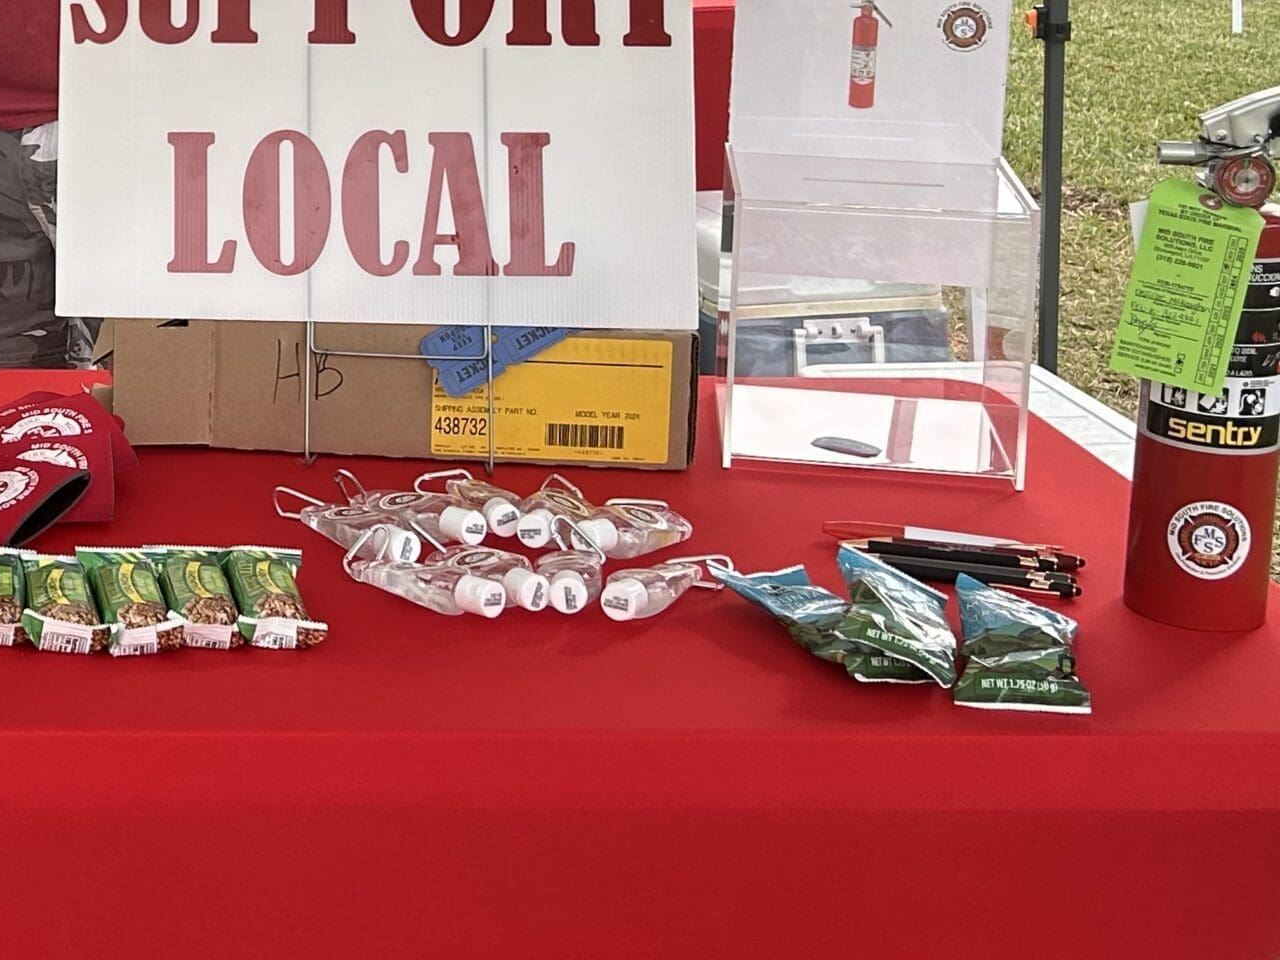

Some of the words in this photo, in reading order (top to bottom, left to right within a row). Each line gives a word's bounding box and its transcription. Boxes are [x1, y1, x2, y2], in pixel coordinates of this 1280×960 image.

[166, 129, 575, 277] LOCAL
[575, 410, 597, 419] MODEL
[601, 411, 620, 419] YEAR
[434, 416, 487, 436] 438732
[1167, 417, 1262, 446] sentry
[1174, 504, 1199, 522] SOUTH
[1200, 504, 1219, 512] FIRE
[866, 629, 880, 638] NET
[871, 657, 882, 666] NET
[981, 679, 995, 689] NET
[1026, 680, 1036, 690] OZ
